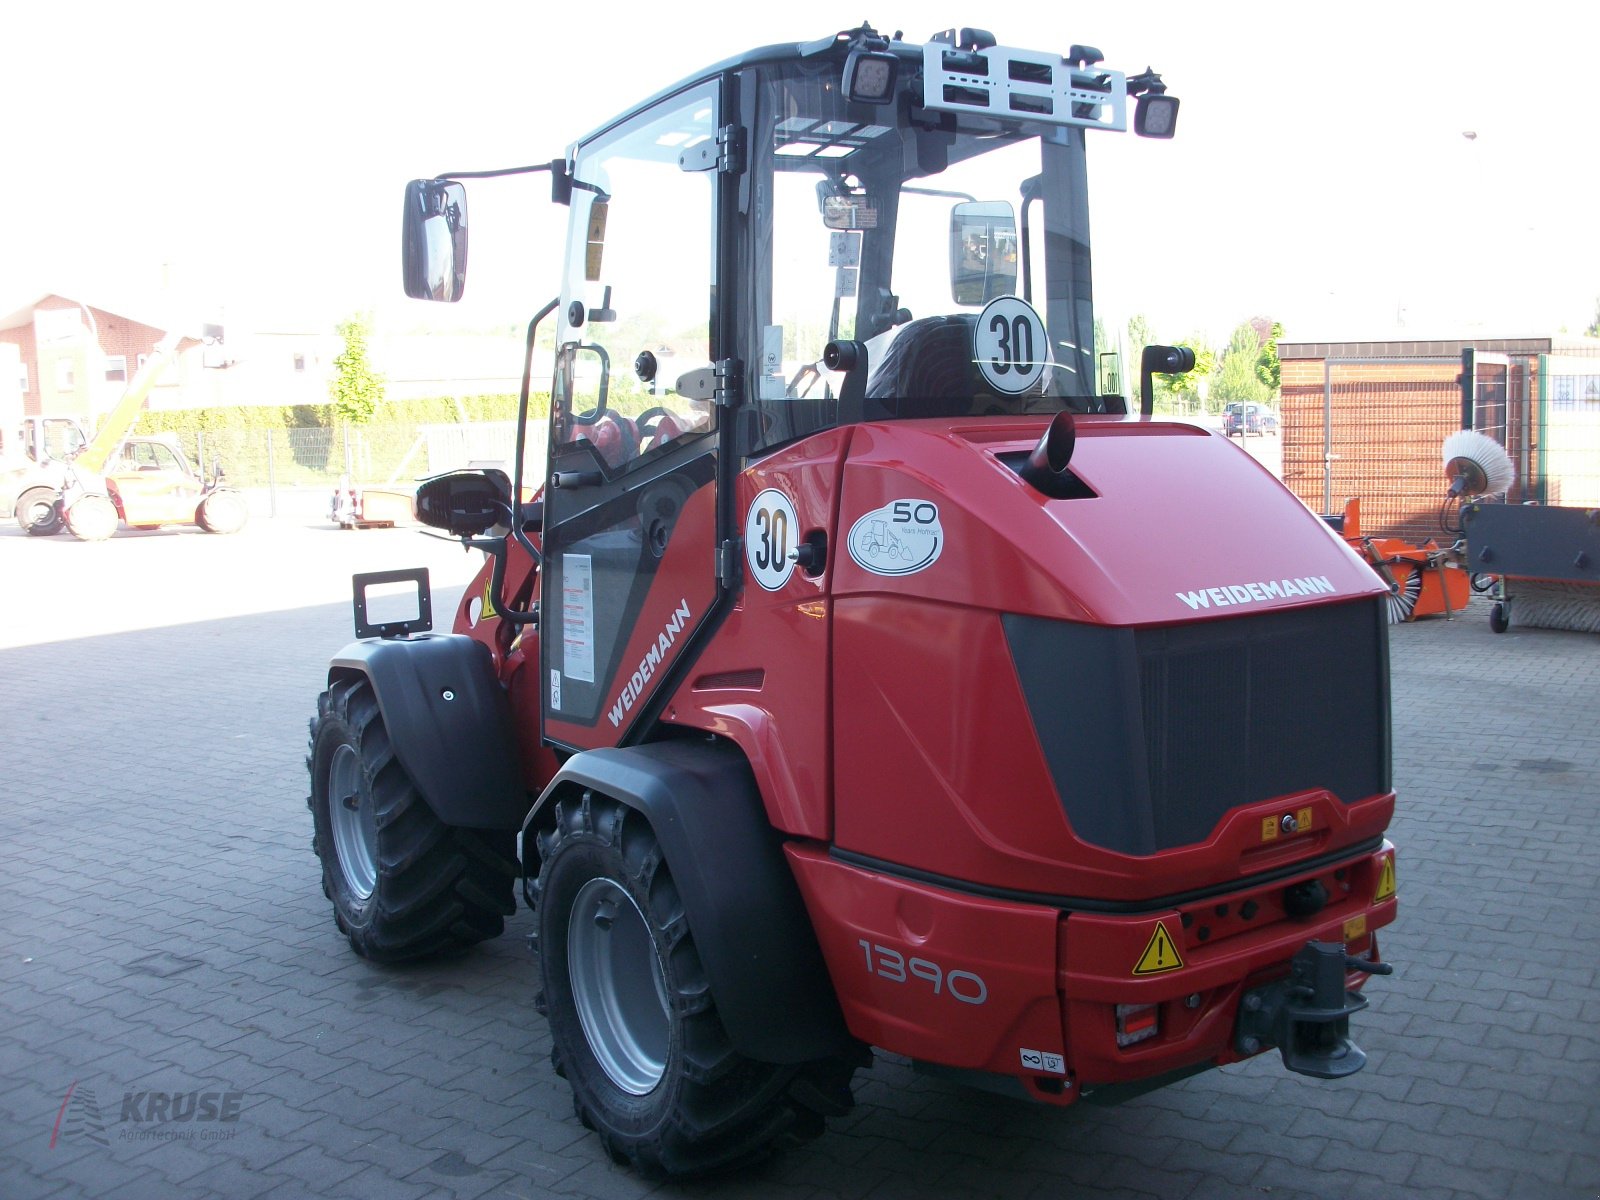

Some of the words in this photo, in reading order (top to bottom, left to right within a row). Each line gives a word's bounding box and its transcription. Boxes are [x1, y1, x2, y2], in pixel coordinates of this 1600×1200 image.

[990, 314, 1033, 375] 30
[756, 507, 787, 573] 30
[893, 503, 937, 524] 50
[1175, 575, 1336, 610] WEIDEMANN
[607, 598, 691, 727] WEIDEMANN
[858, 939, 988, 1005] 1390
